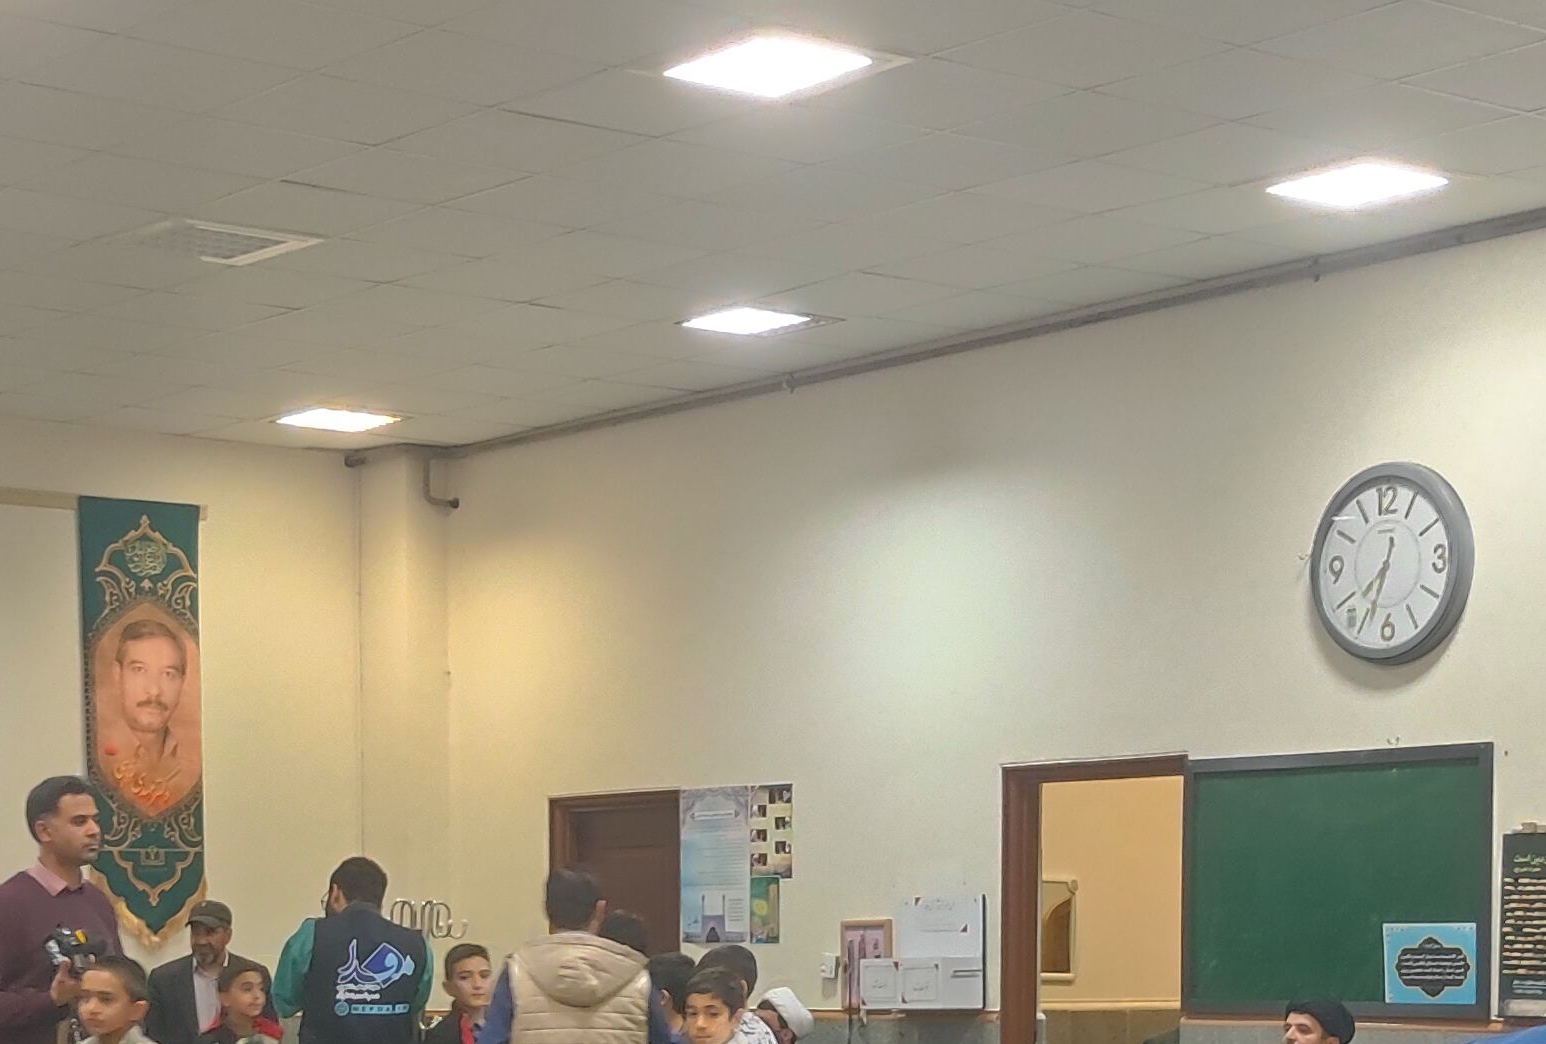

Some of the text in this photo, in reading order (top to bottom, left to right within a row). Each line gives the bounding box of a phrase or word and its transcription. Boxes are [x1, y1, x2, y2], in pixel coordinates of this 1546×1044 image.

[1375, 486, 1399, 516] 12
[1328, 555, 1345, 585] 9
[1432, 543, 1447, 574] 3
[1380, 613, 1396, 641] 6
